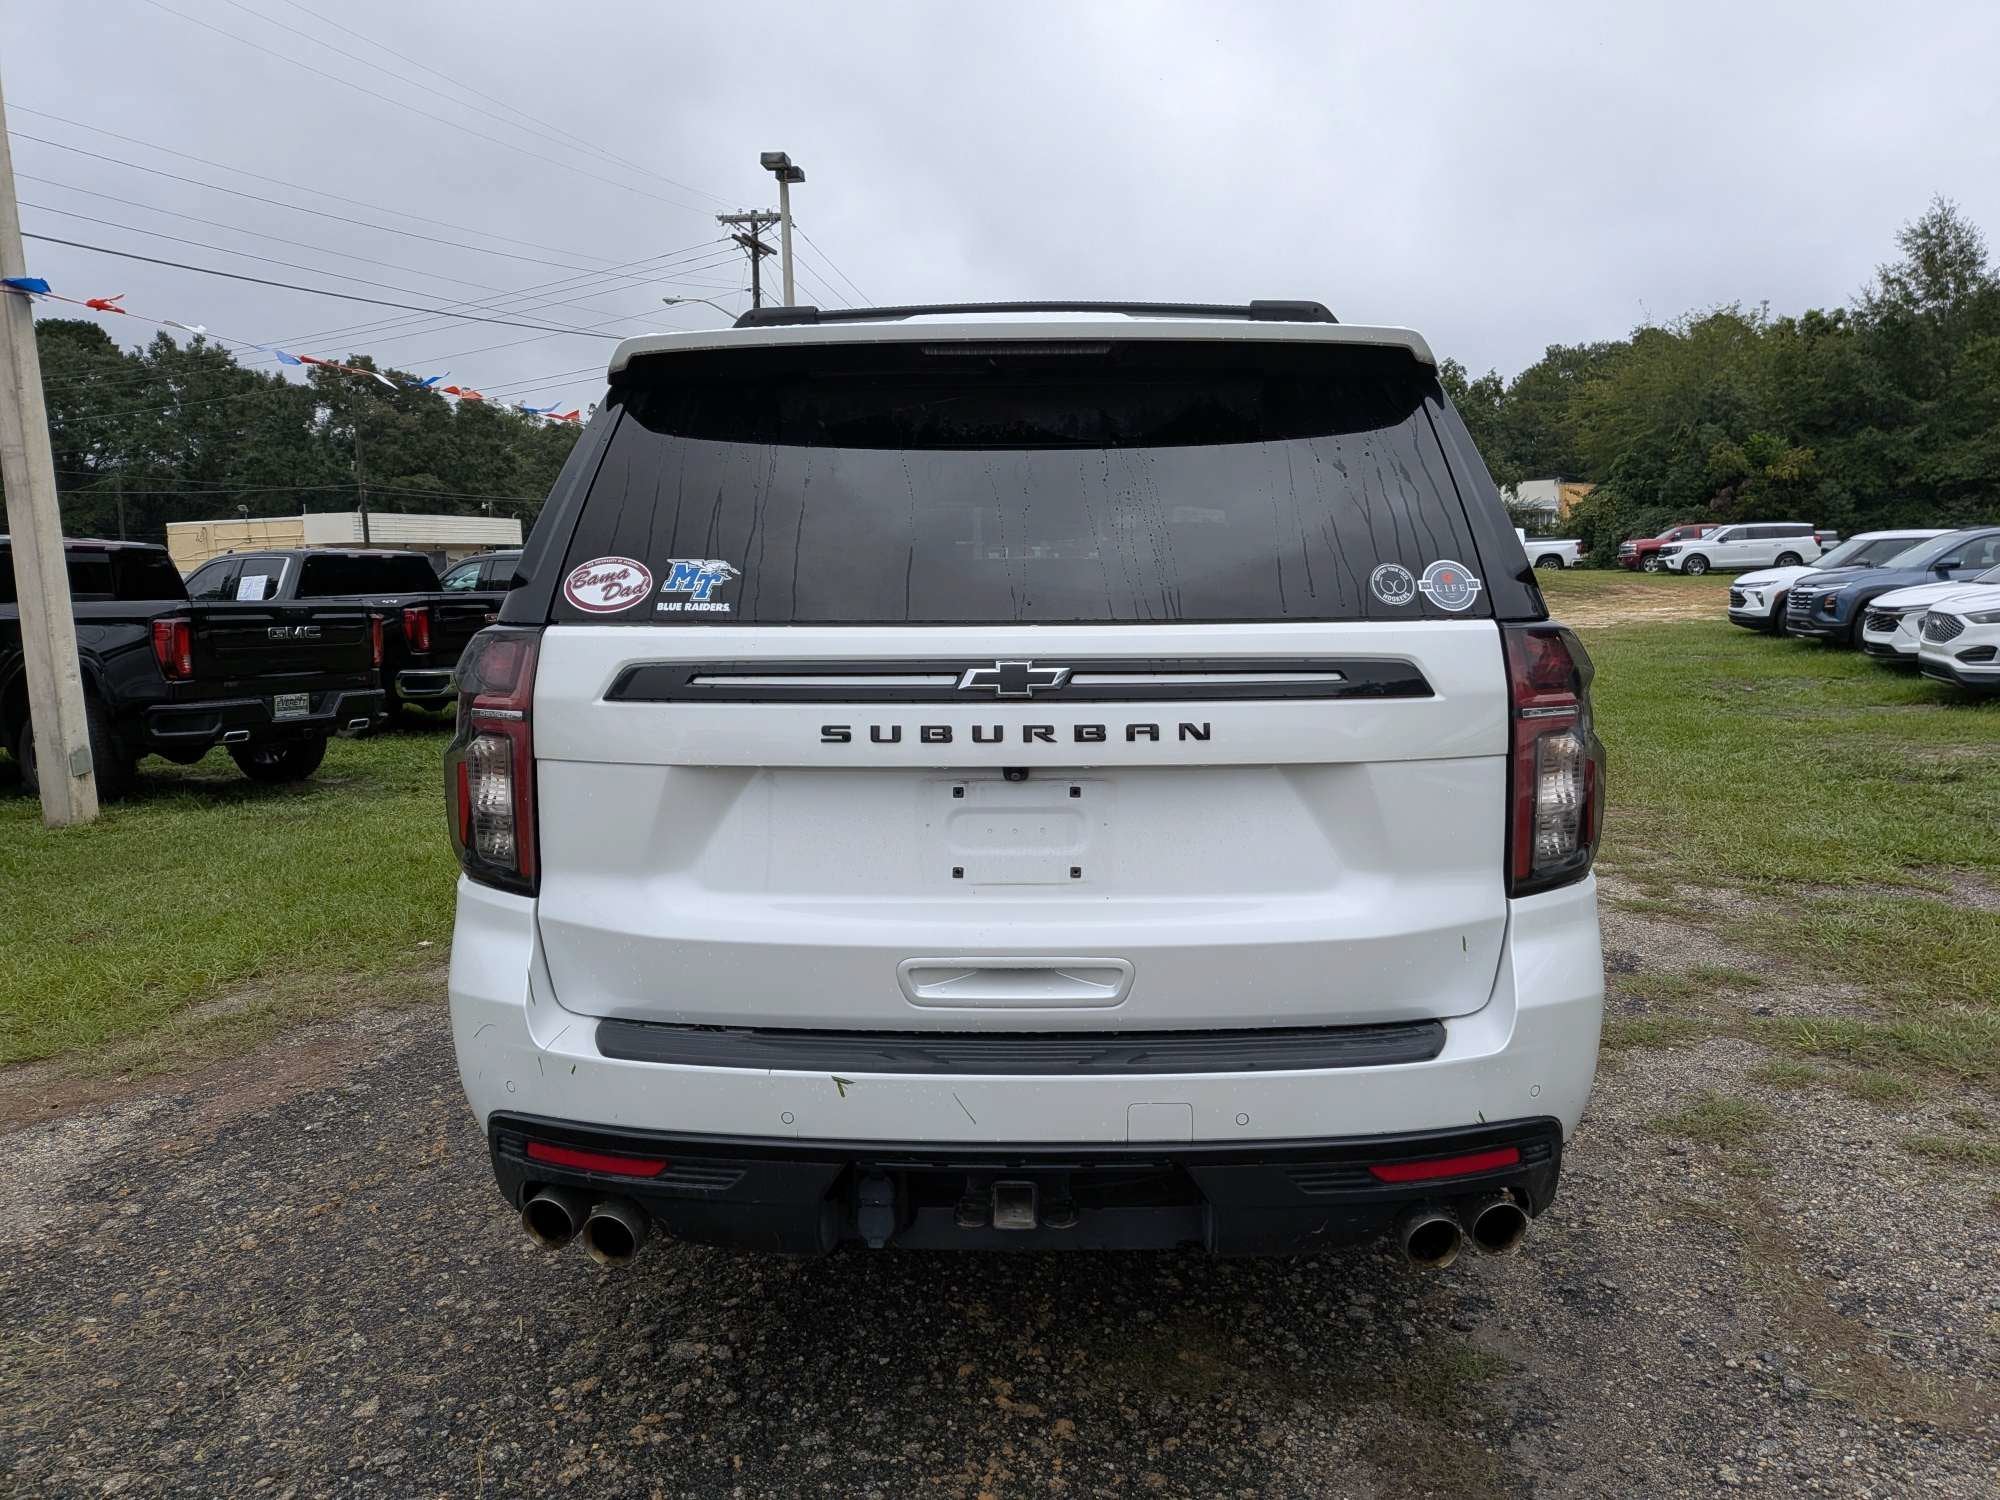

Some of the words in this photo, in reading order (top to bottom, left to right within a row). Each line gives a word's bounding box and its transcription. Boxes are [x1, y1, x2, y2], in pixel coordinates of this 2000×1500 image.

[570, 567, 631, 589] Bama
[601, 575, 649, 601] Dad
[660, 562, 724, 601] MT
[1434, 584, 1466, 592] LIFE
[656, 602, 683, 611] BLUE
[685, 602, 730, 612] RAIDERS
[267, 626, 322, 639] GMC
[820, 722, 1211, 744] SUBURBAN
